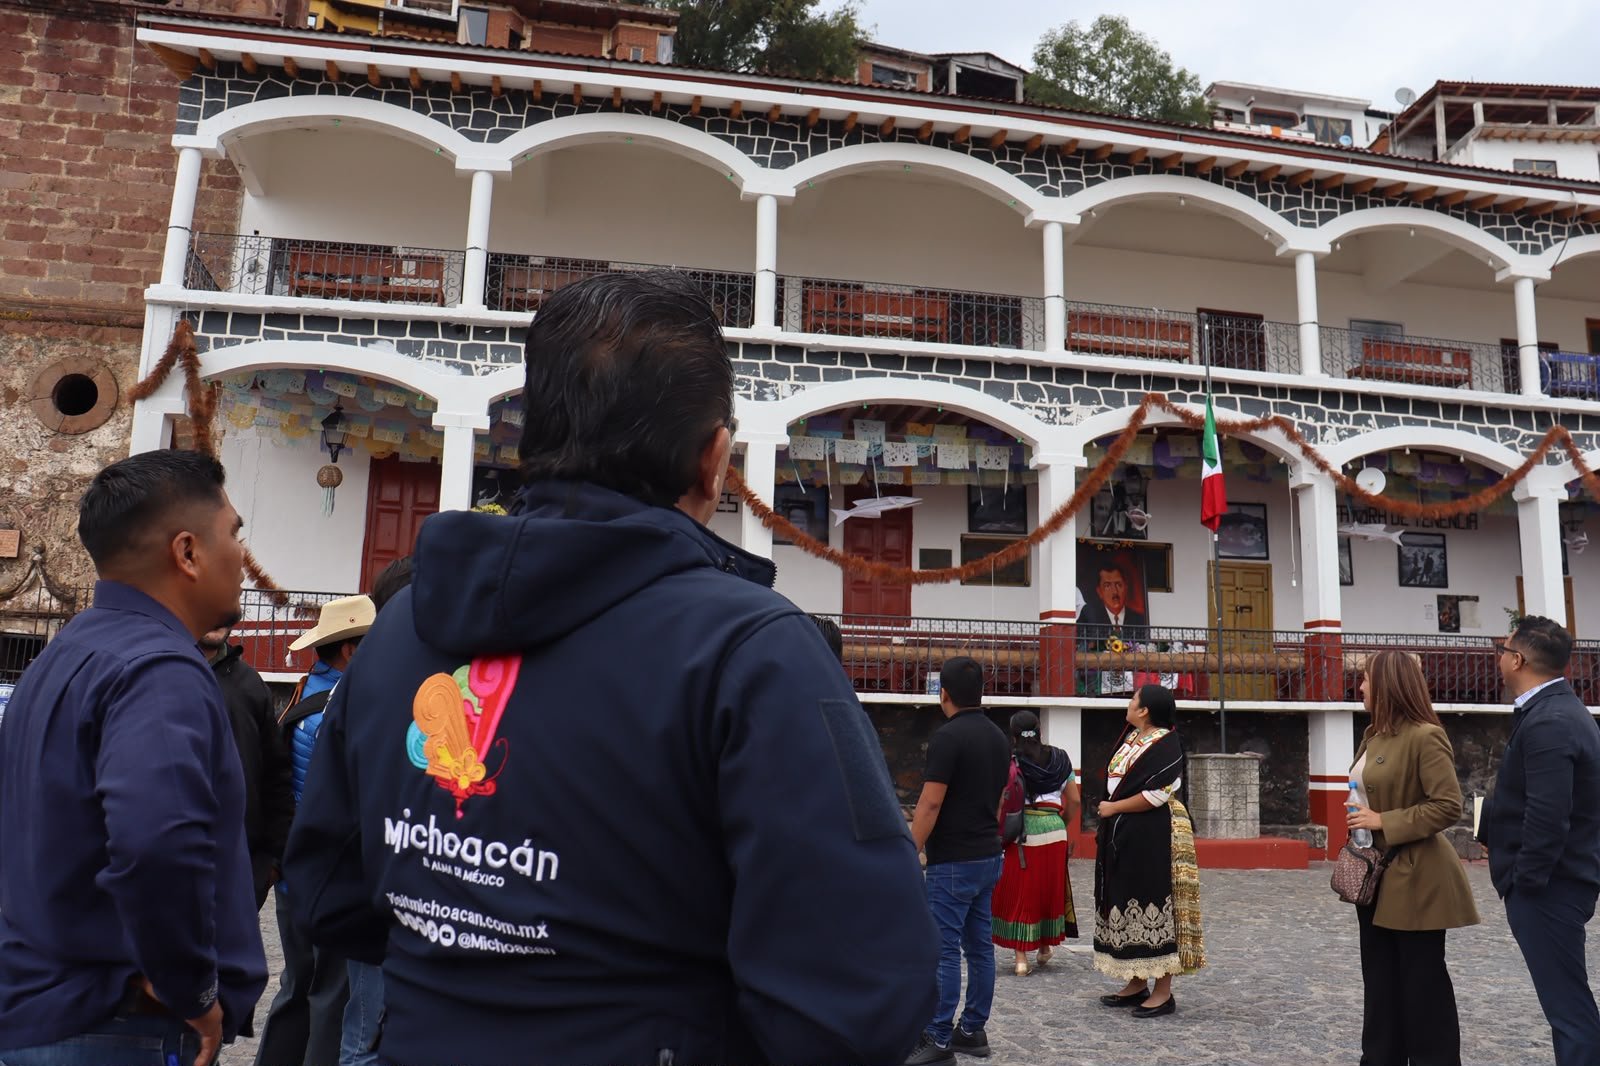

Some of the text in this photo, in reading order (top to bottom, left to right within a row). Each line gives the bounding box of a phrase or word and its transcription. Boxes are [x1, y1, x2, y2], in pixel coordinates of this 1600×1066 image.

[384, 808, 559, 882] Michoacán
[431, 860, 453, 875] ALMA
[462, 868, 505, 888] MÉXICO
